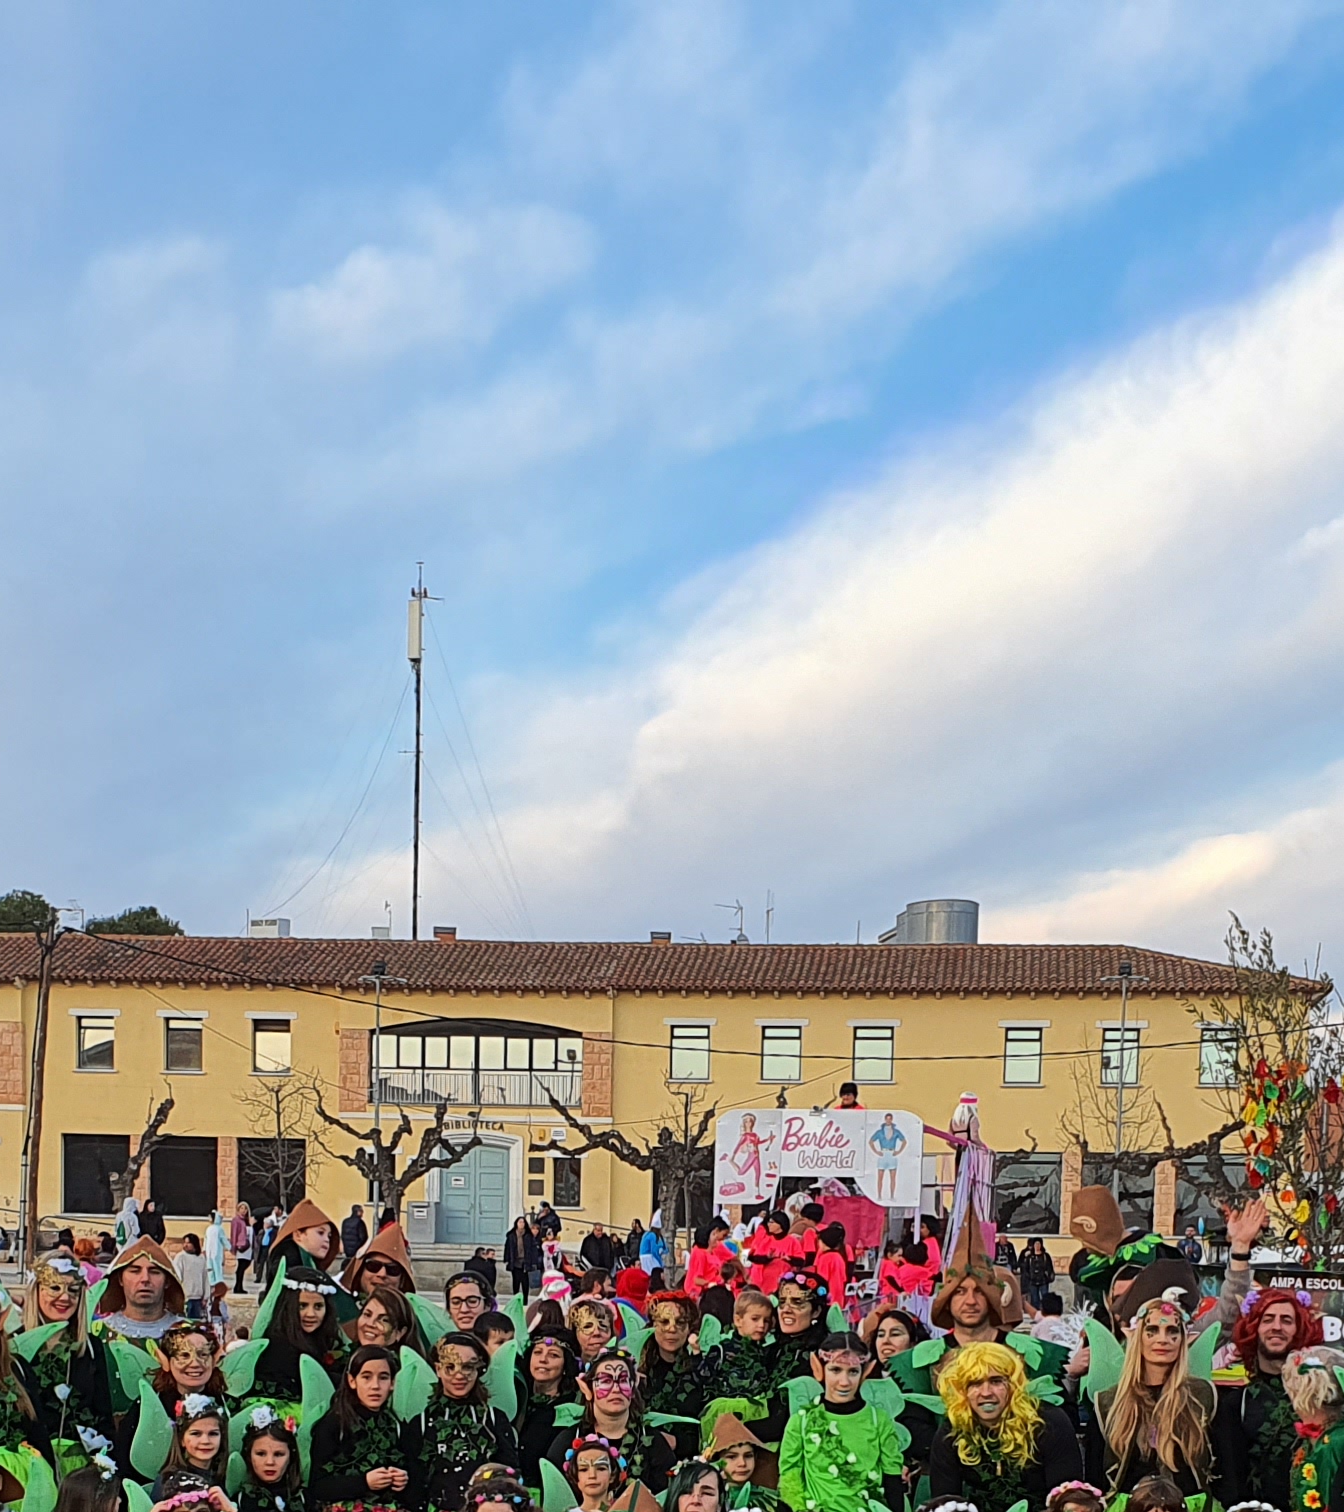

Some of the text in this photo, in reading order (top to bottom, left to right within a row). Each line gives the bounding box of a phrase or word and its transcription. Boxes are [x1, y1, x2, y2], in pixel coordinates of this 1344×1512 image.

[443, 1120, 505, 1132] BIBLIOTECA
[781, 1116, 851, 1152] Barbie
[798, 1149, 856, 1169] World
[1269, 1276, 1303, 1288] AMPA
